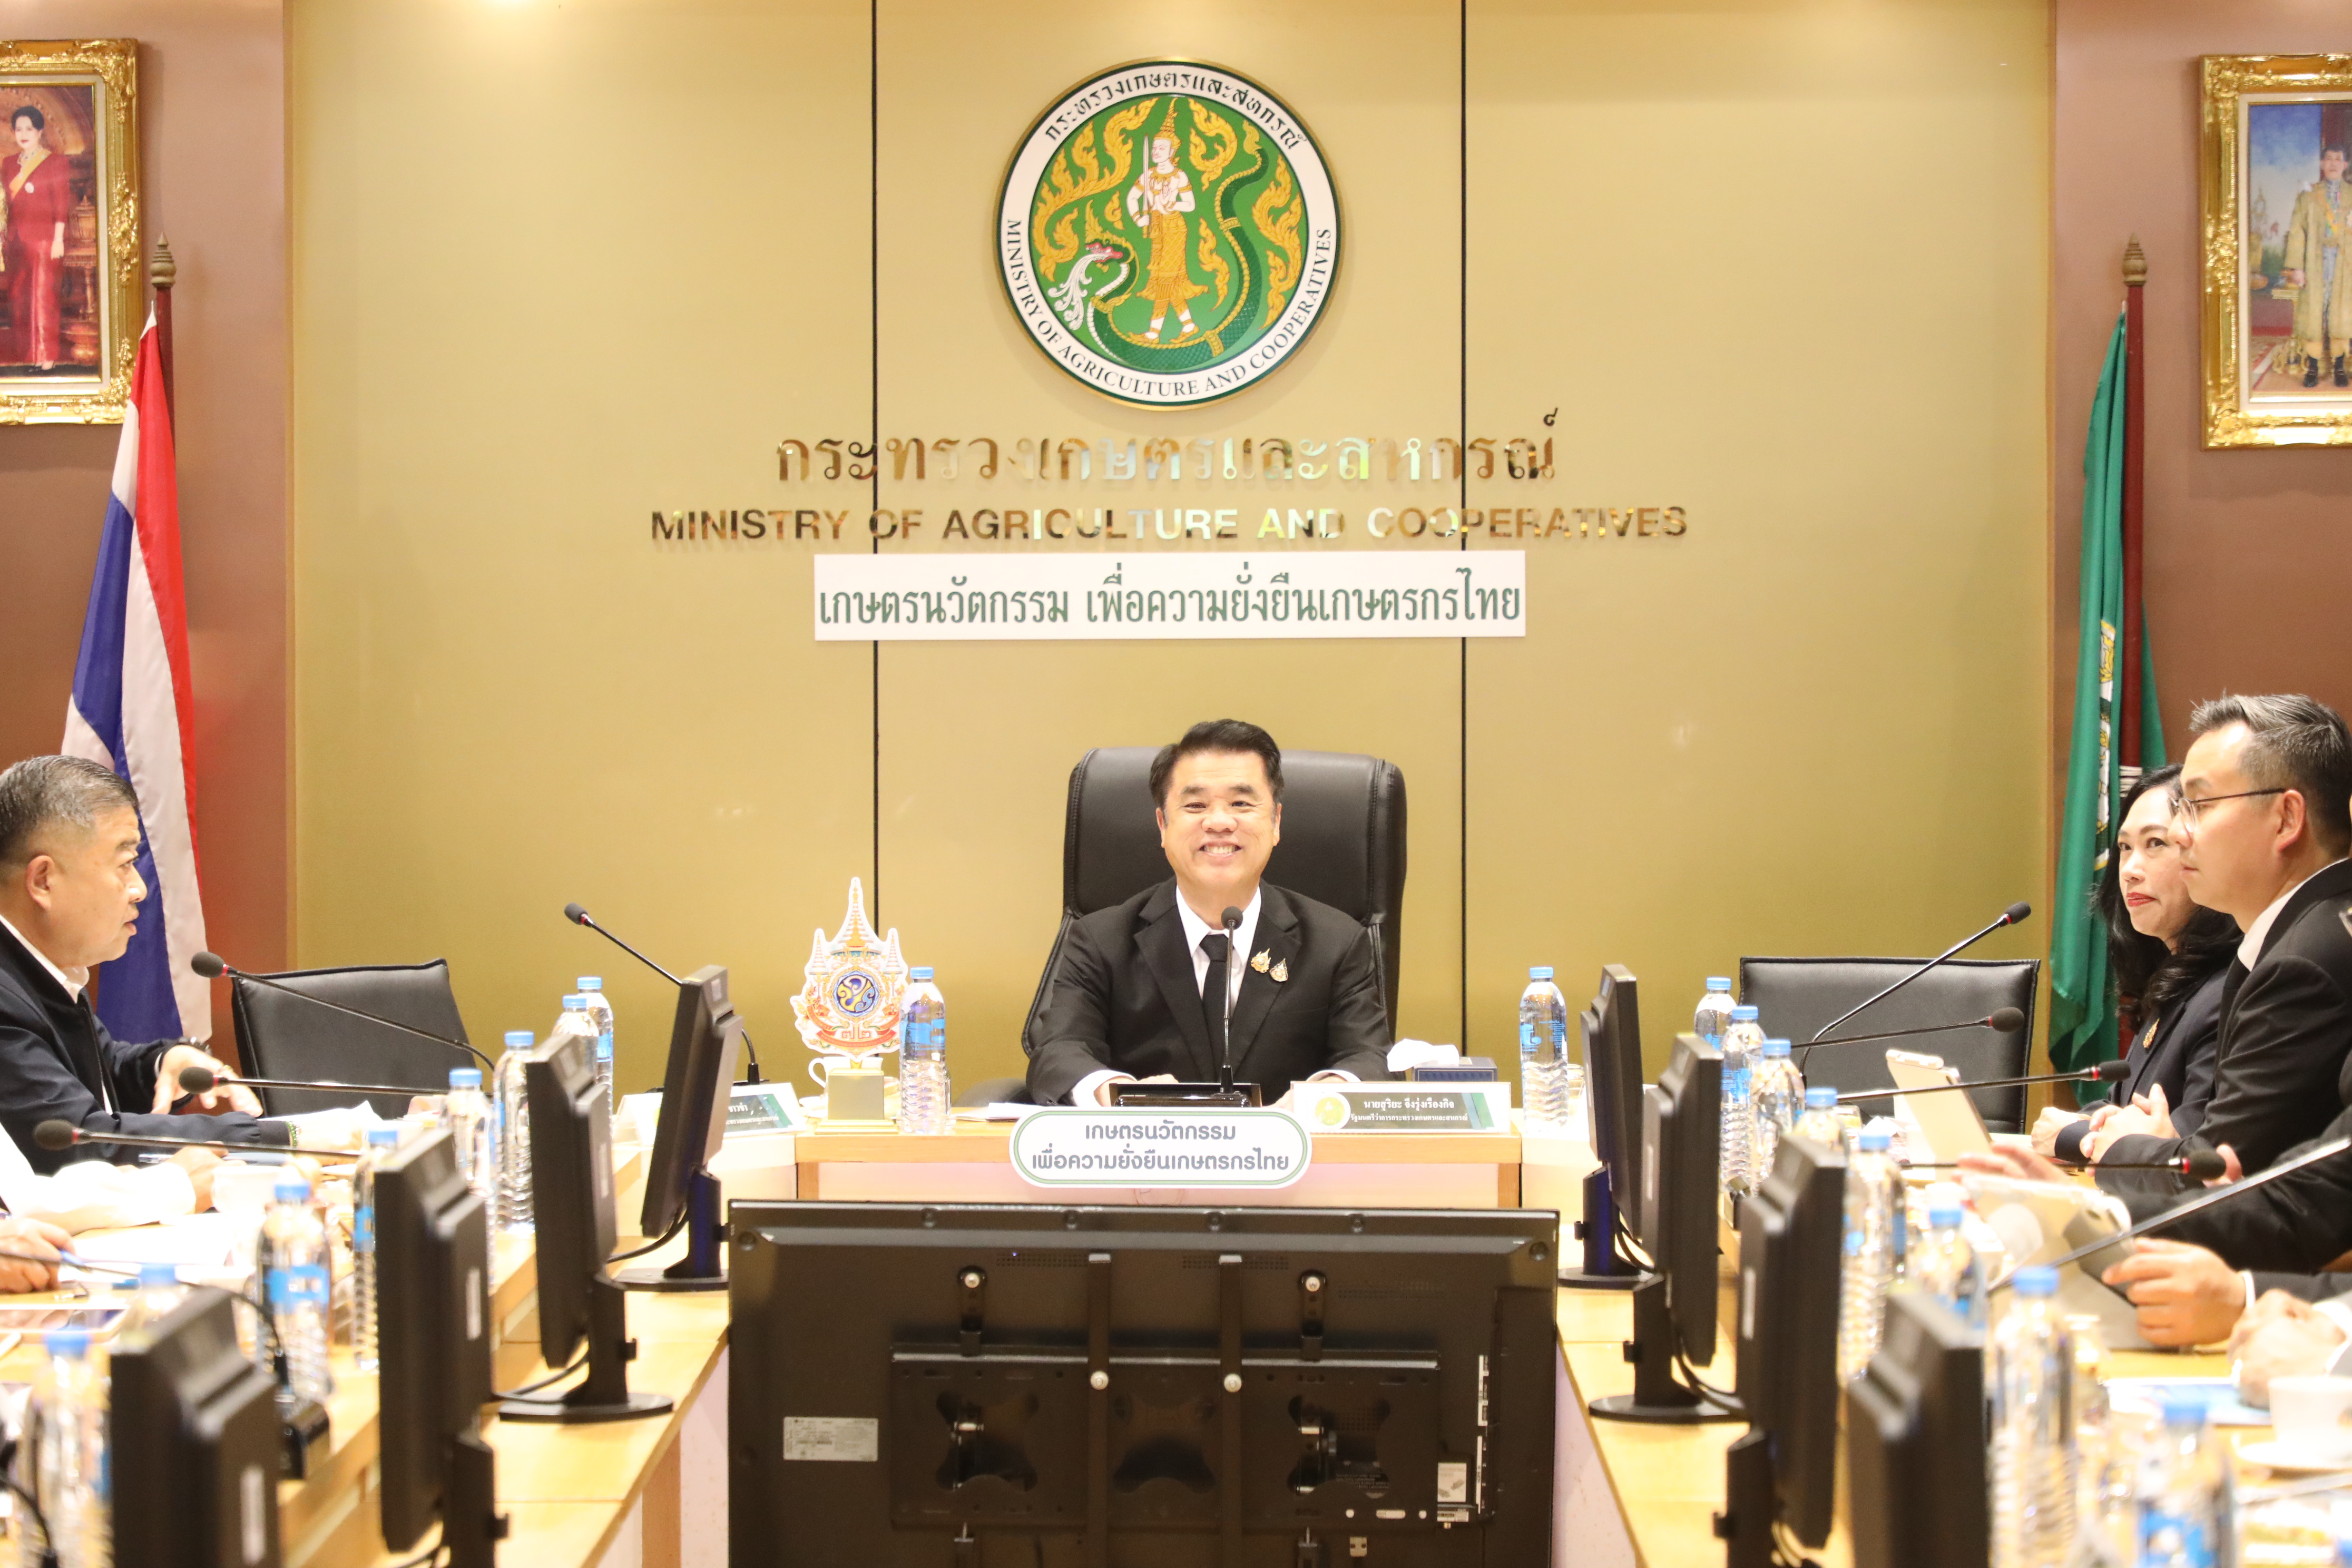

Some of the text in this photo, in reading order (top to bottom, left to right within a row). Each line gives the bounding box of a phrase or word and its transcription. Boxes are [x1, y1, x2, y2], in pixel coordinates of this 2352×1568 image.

[1045, 71, 1308, 150] กระทรวงเกษตรและสหกรณ์
[1006, 219, 1332, 397] MINISTRY OF AGRICULTURE AND COOPERATIVES
[777, 408, 1559, 480] กระทรวงเกษตรและสหกรณ์
[652, 506, 1688, 540] MINISTRY OF AGRICULTURE AND COOPERATIVES
[820, 562, 1521, 624] เกษตรนวัตกรรม เพื่อความยั่งยืนเกษตรกรไทย
[1364, 1097, 1403, 1111] นายสุริยะ
[1085, 1120, 1236, 1140] เกษตรนวัตกรรม
[1032, 1143, 1289, 1170] เพื่อความยั่งยืนเกษตรกรไทย
